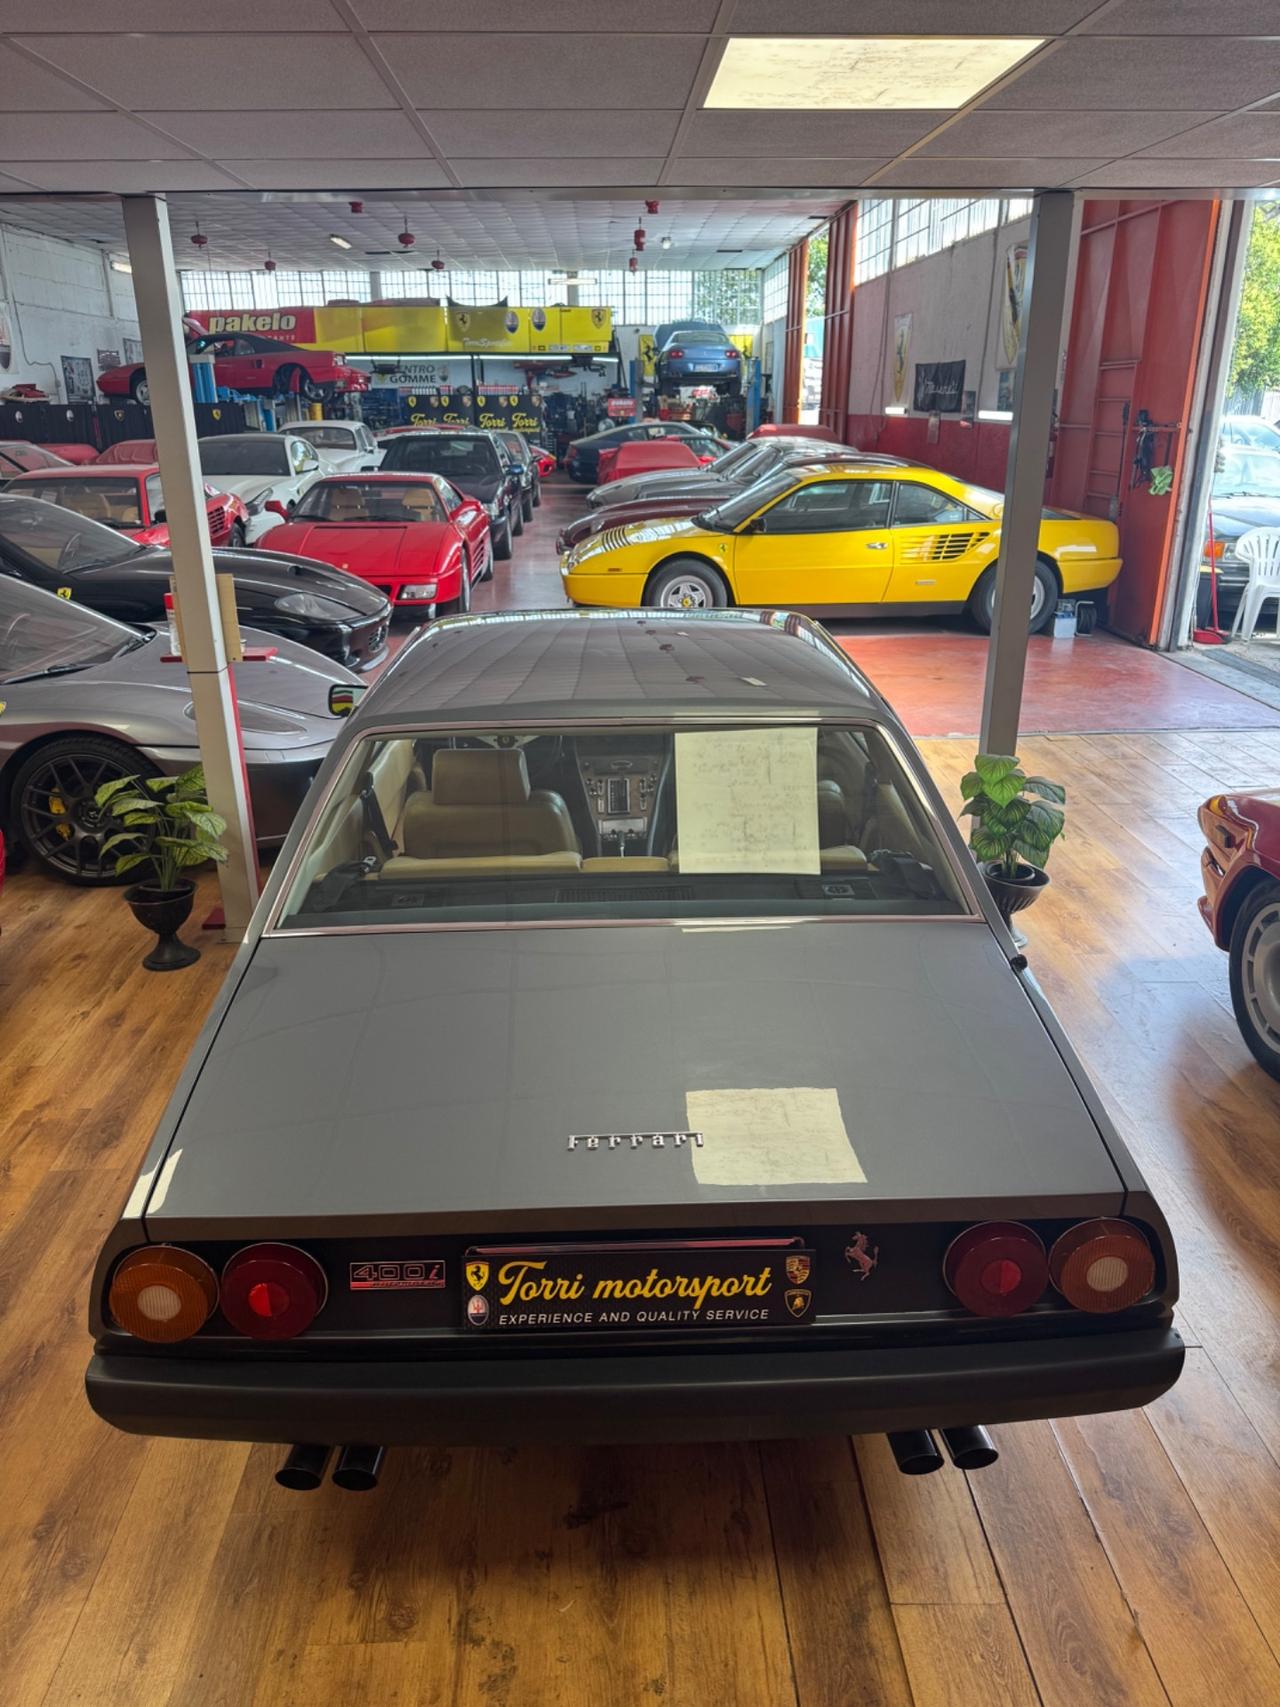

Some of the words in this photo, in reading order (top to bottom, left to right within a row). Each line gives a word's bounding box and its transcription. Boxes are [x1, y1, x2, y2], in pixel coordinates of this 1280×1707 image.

[208, 313, 296, 334] pakelo
[389, 374, 437, 384] GOMME
[479, 412, 505, 428] Torri
[511, 412, 538, 428] Torri
[568, 1131, 704, 1150] Ferrari
[353, 1263, 441, 1281] 400i
[497, 1260, 585, 1306] Torri
[592, 1266, 773, 1310] motorsport
[498, 1312, 593, 1325] EXPERIENCE
[598, 1311, 631, 1323] AND
[636, 1309, 701, 1322] QUALITY
[705, 1308, 770, 1321] SERVICE
